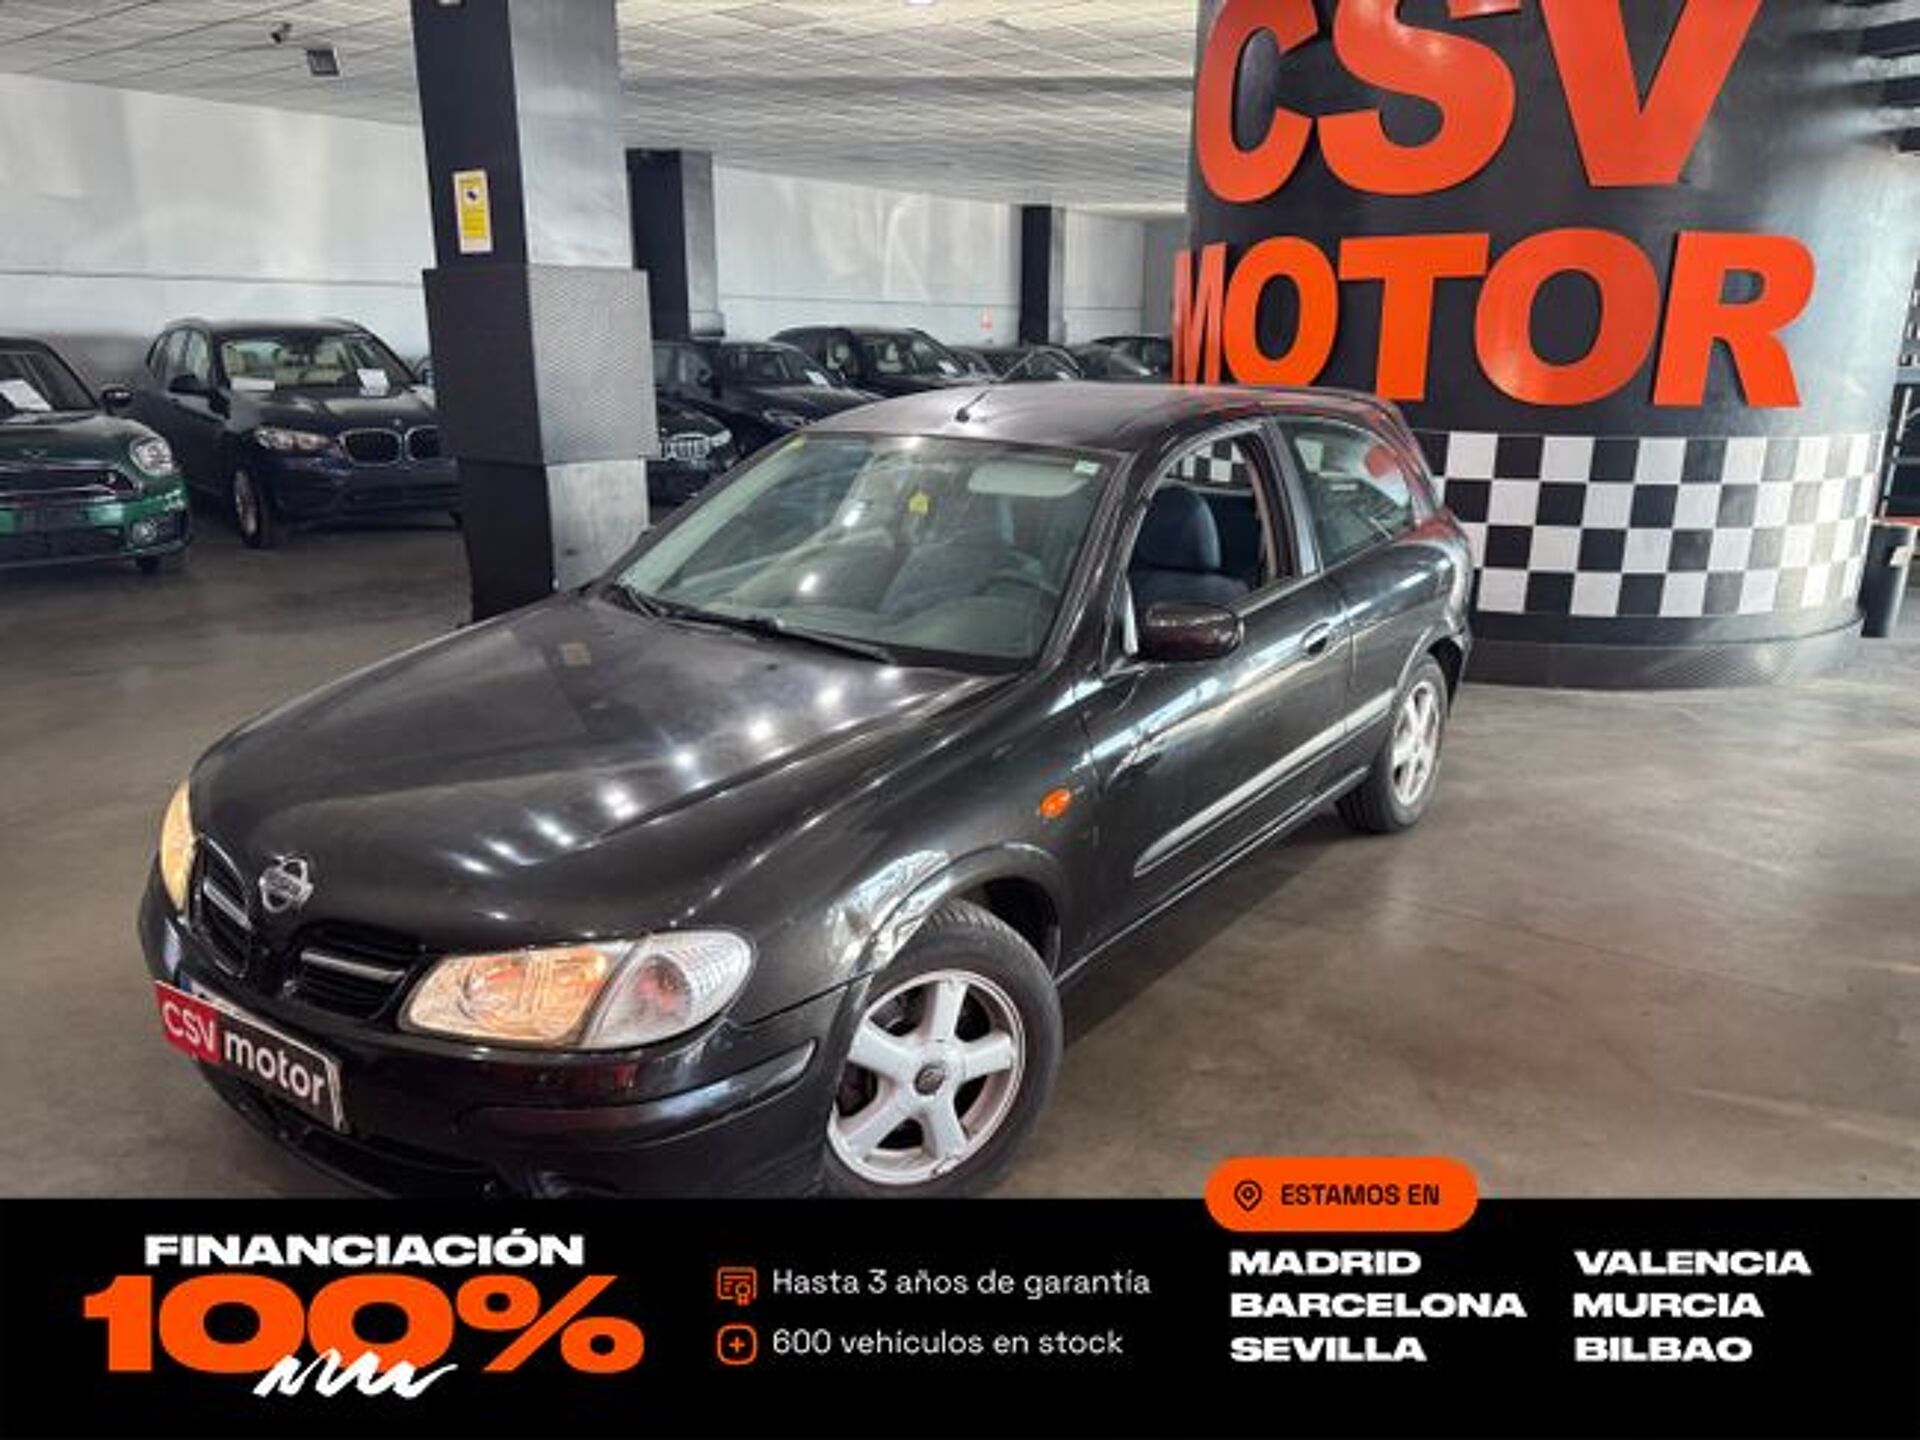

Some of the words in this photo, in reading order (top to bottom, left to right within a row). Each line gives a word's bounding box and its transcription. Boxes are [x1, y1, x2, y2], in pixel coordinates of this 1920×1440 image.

[1196, 0, 1764, 202] CSV
[1173, 227, 1816, 409] MOTOR
[161, 1001, 217, 1055] CSV
[223, 1029, 326, 1106] motor
